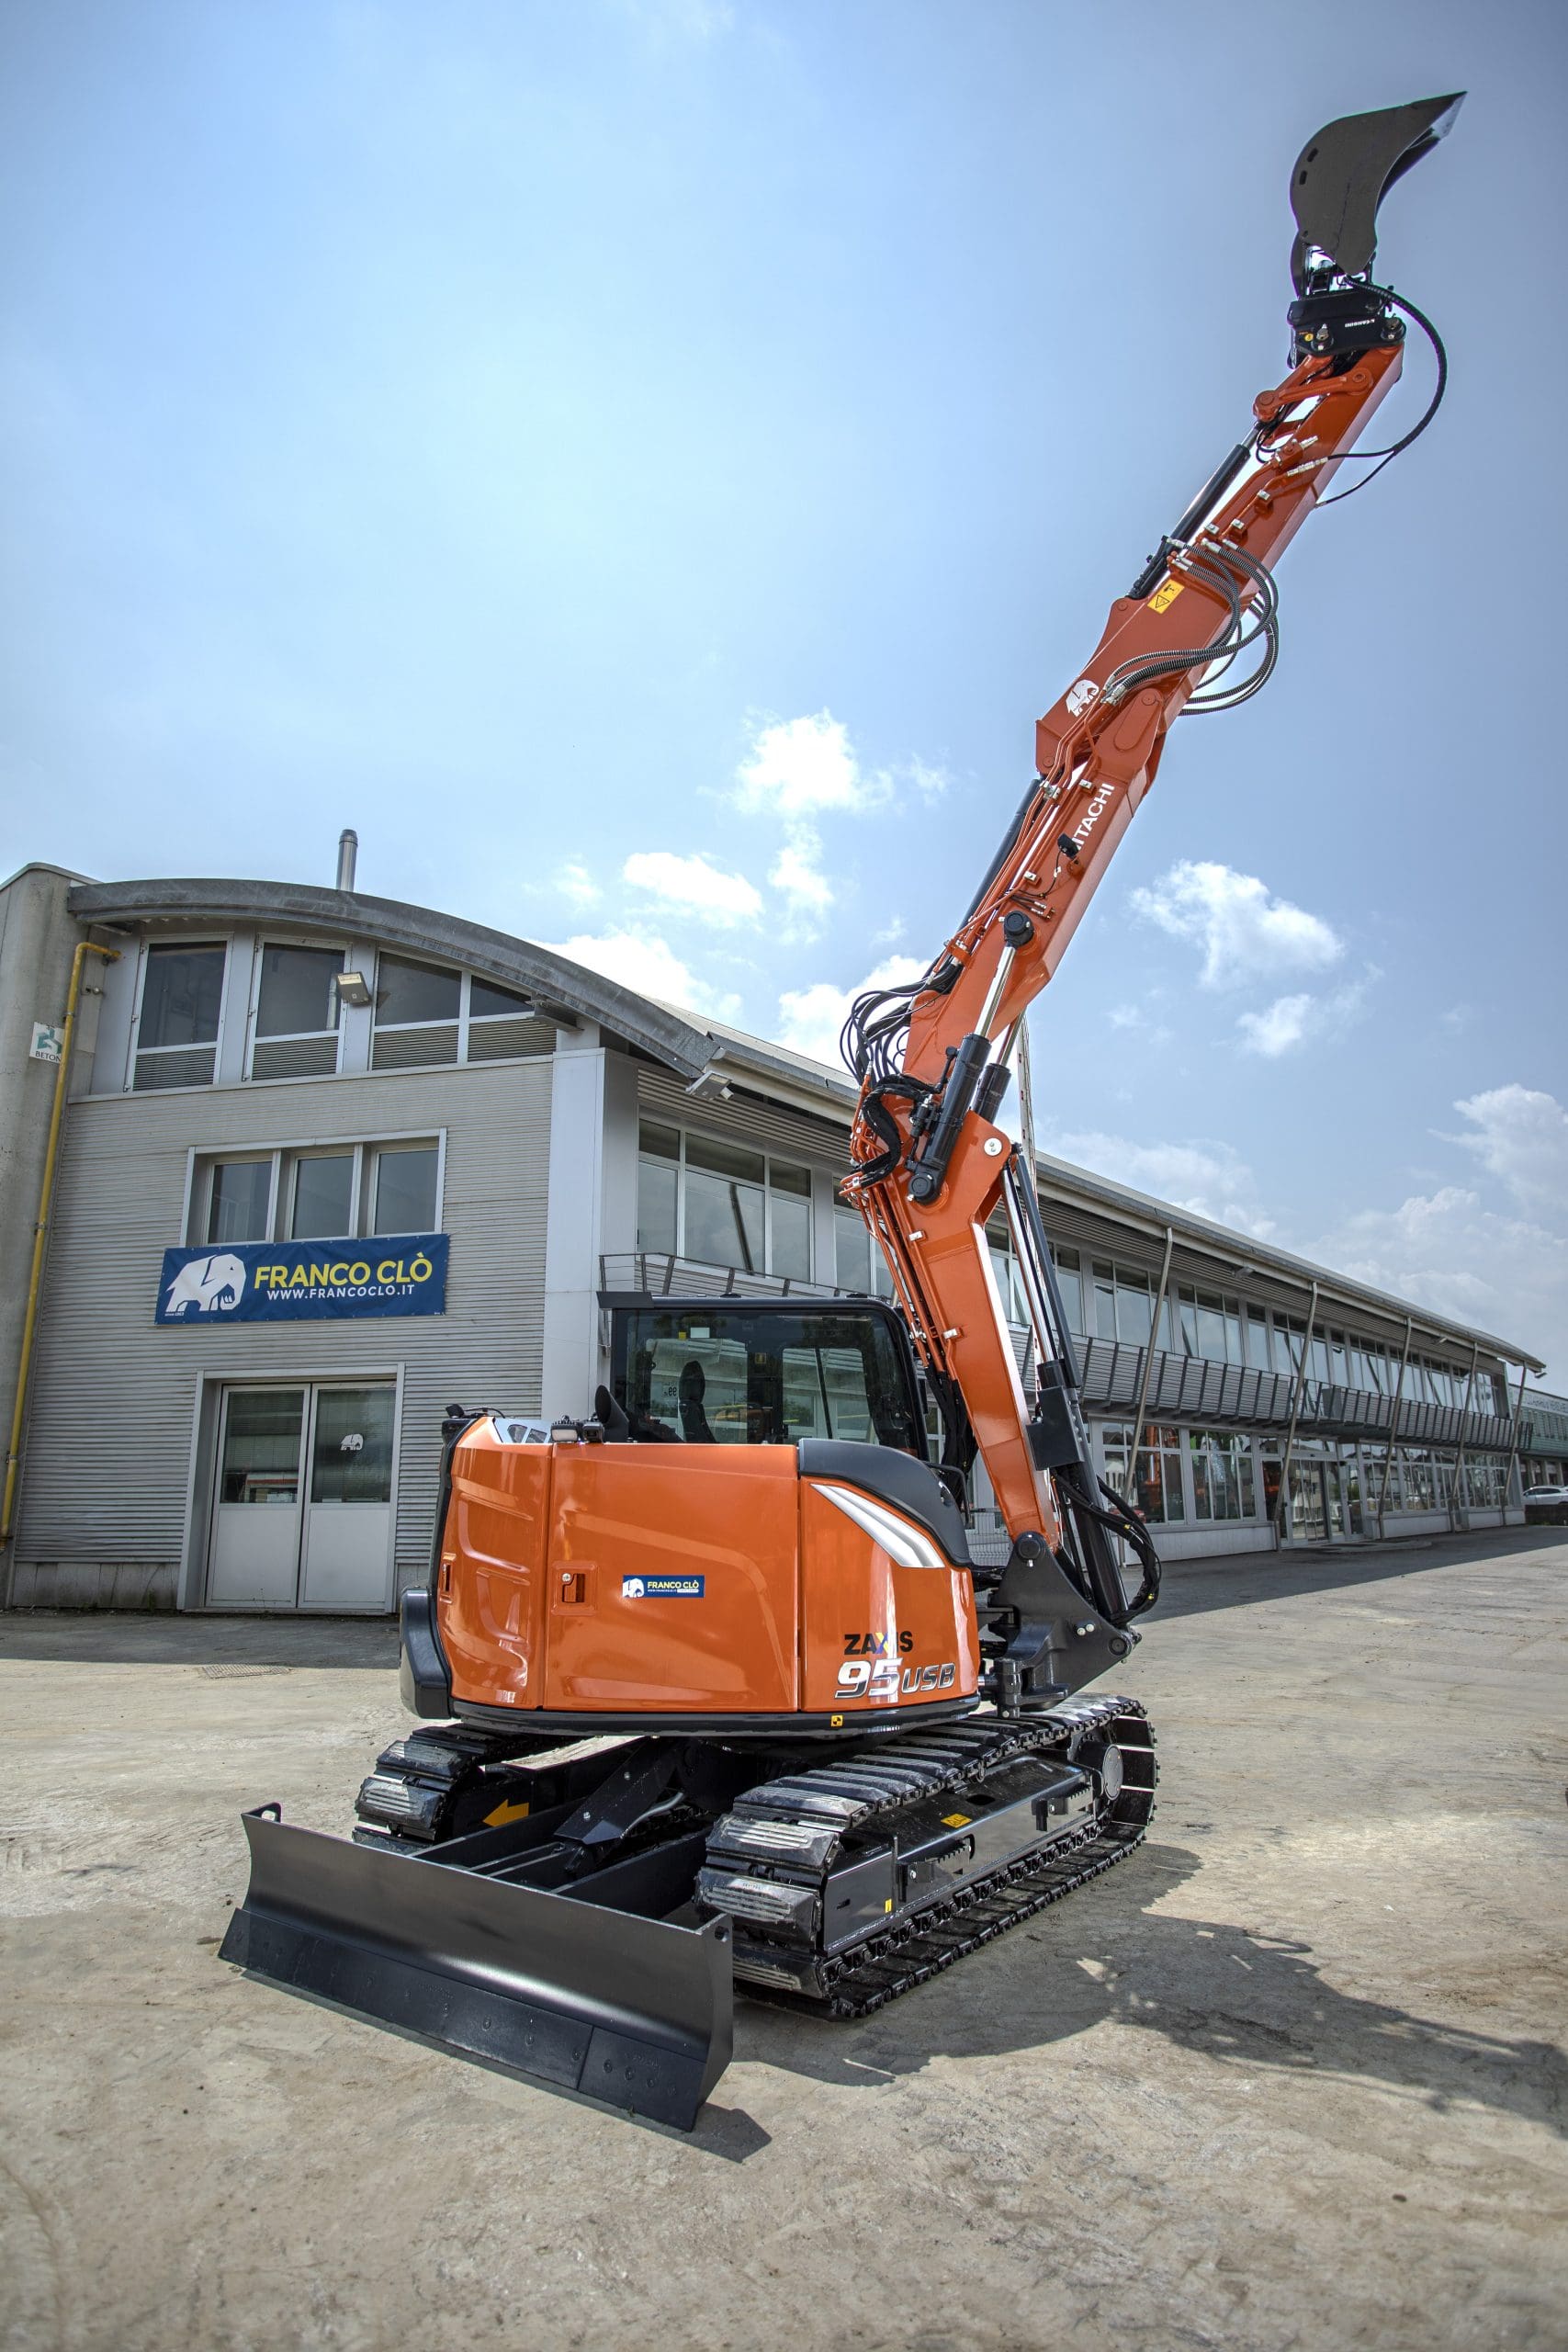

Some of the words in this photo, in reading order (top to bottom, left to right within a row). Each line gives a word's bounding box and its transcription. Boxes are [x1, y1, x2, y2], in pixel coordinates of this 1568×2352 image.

[1072, 783, 1115, 851] ITACHI
[254, 1261, 371, 1289] FRANCO
[377, 1251, 433, 1283] CLÒ
[267, 1284, 415, 1300] WWW.FRANCOCLO.IT
[834, 1657, 903, 1699] 95
[902, 1662, 955, 1693] USB
